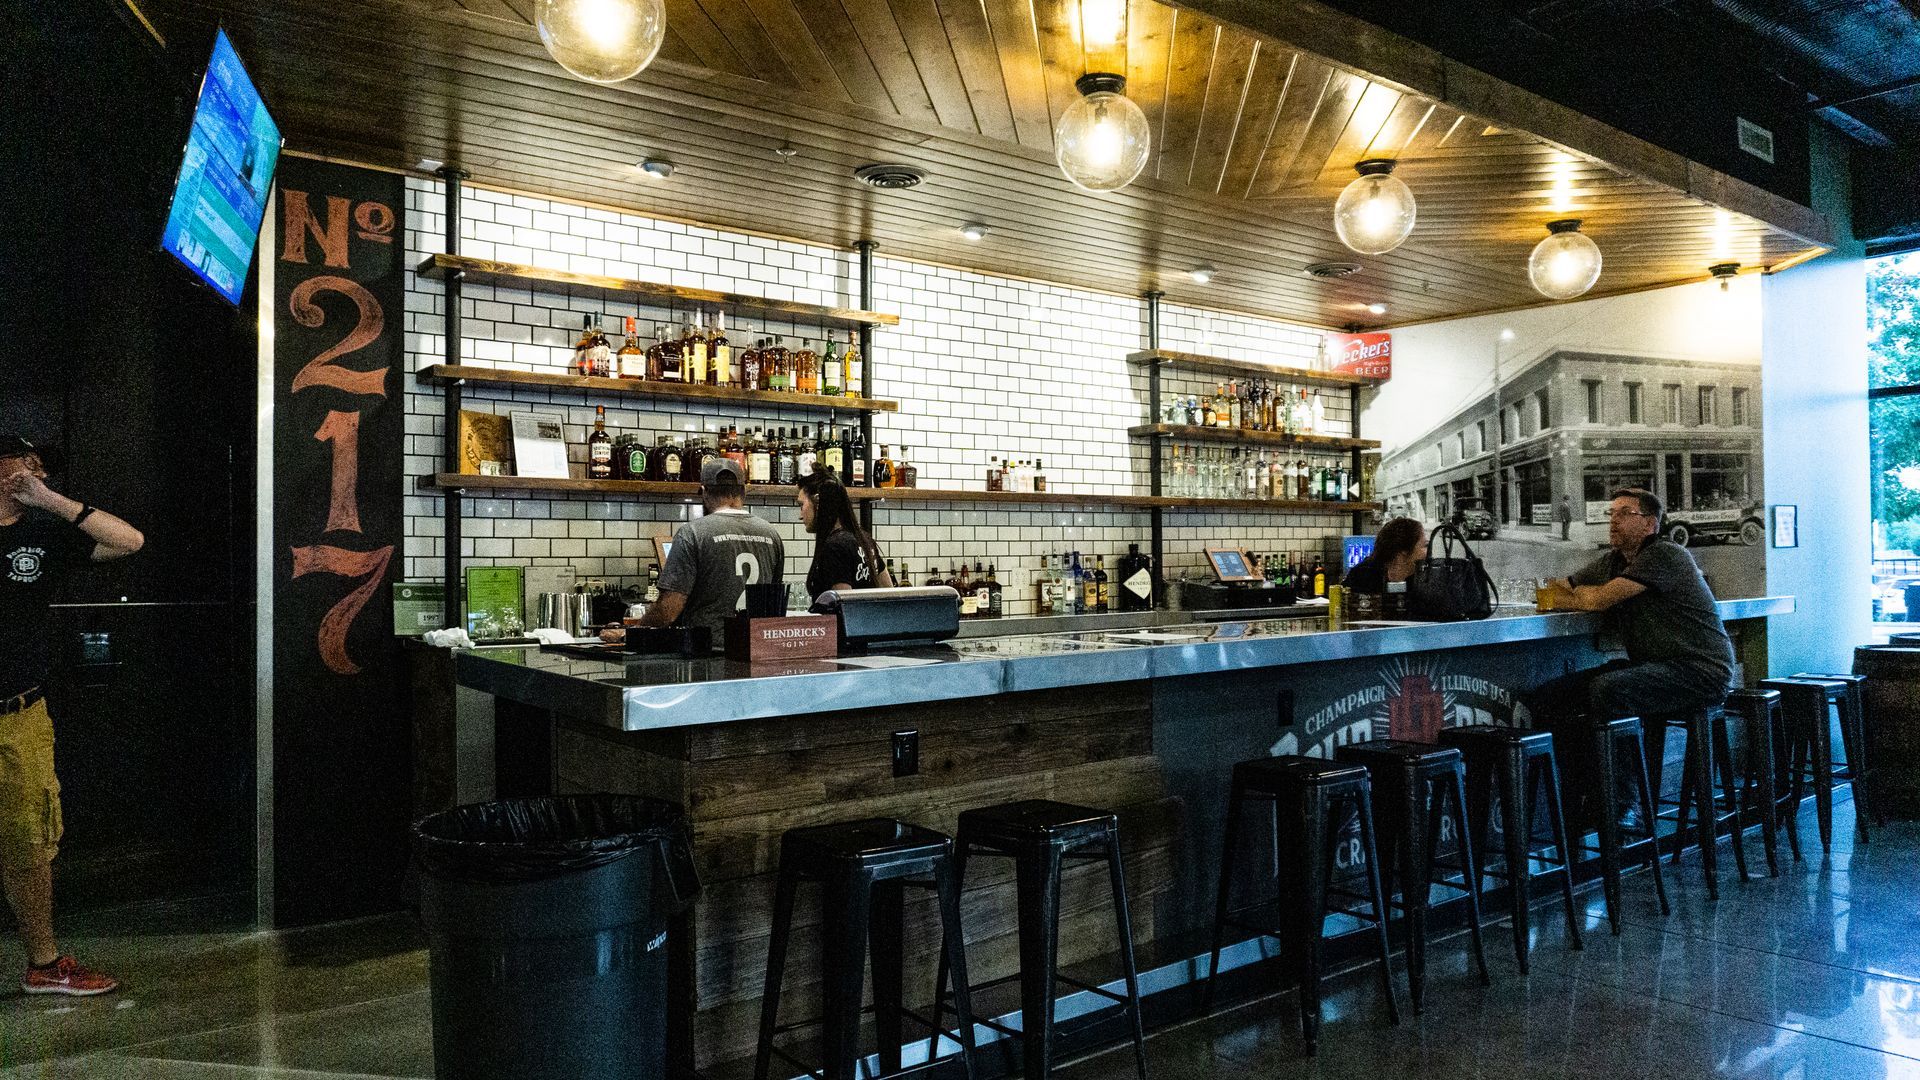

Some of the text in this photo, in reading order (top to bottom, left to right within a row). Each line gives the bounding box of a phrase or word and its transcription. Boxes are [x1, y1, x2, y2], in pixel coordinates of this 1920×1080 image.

[1355, 366, 1389, 375] BEER
[763, 627, 826, 639] HENDRICK'S
[1441, 674, 1512, 708] ILLINOIS USA
[1305, 685, 1387, 736] CHAMPAIGN
